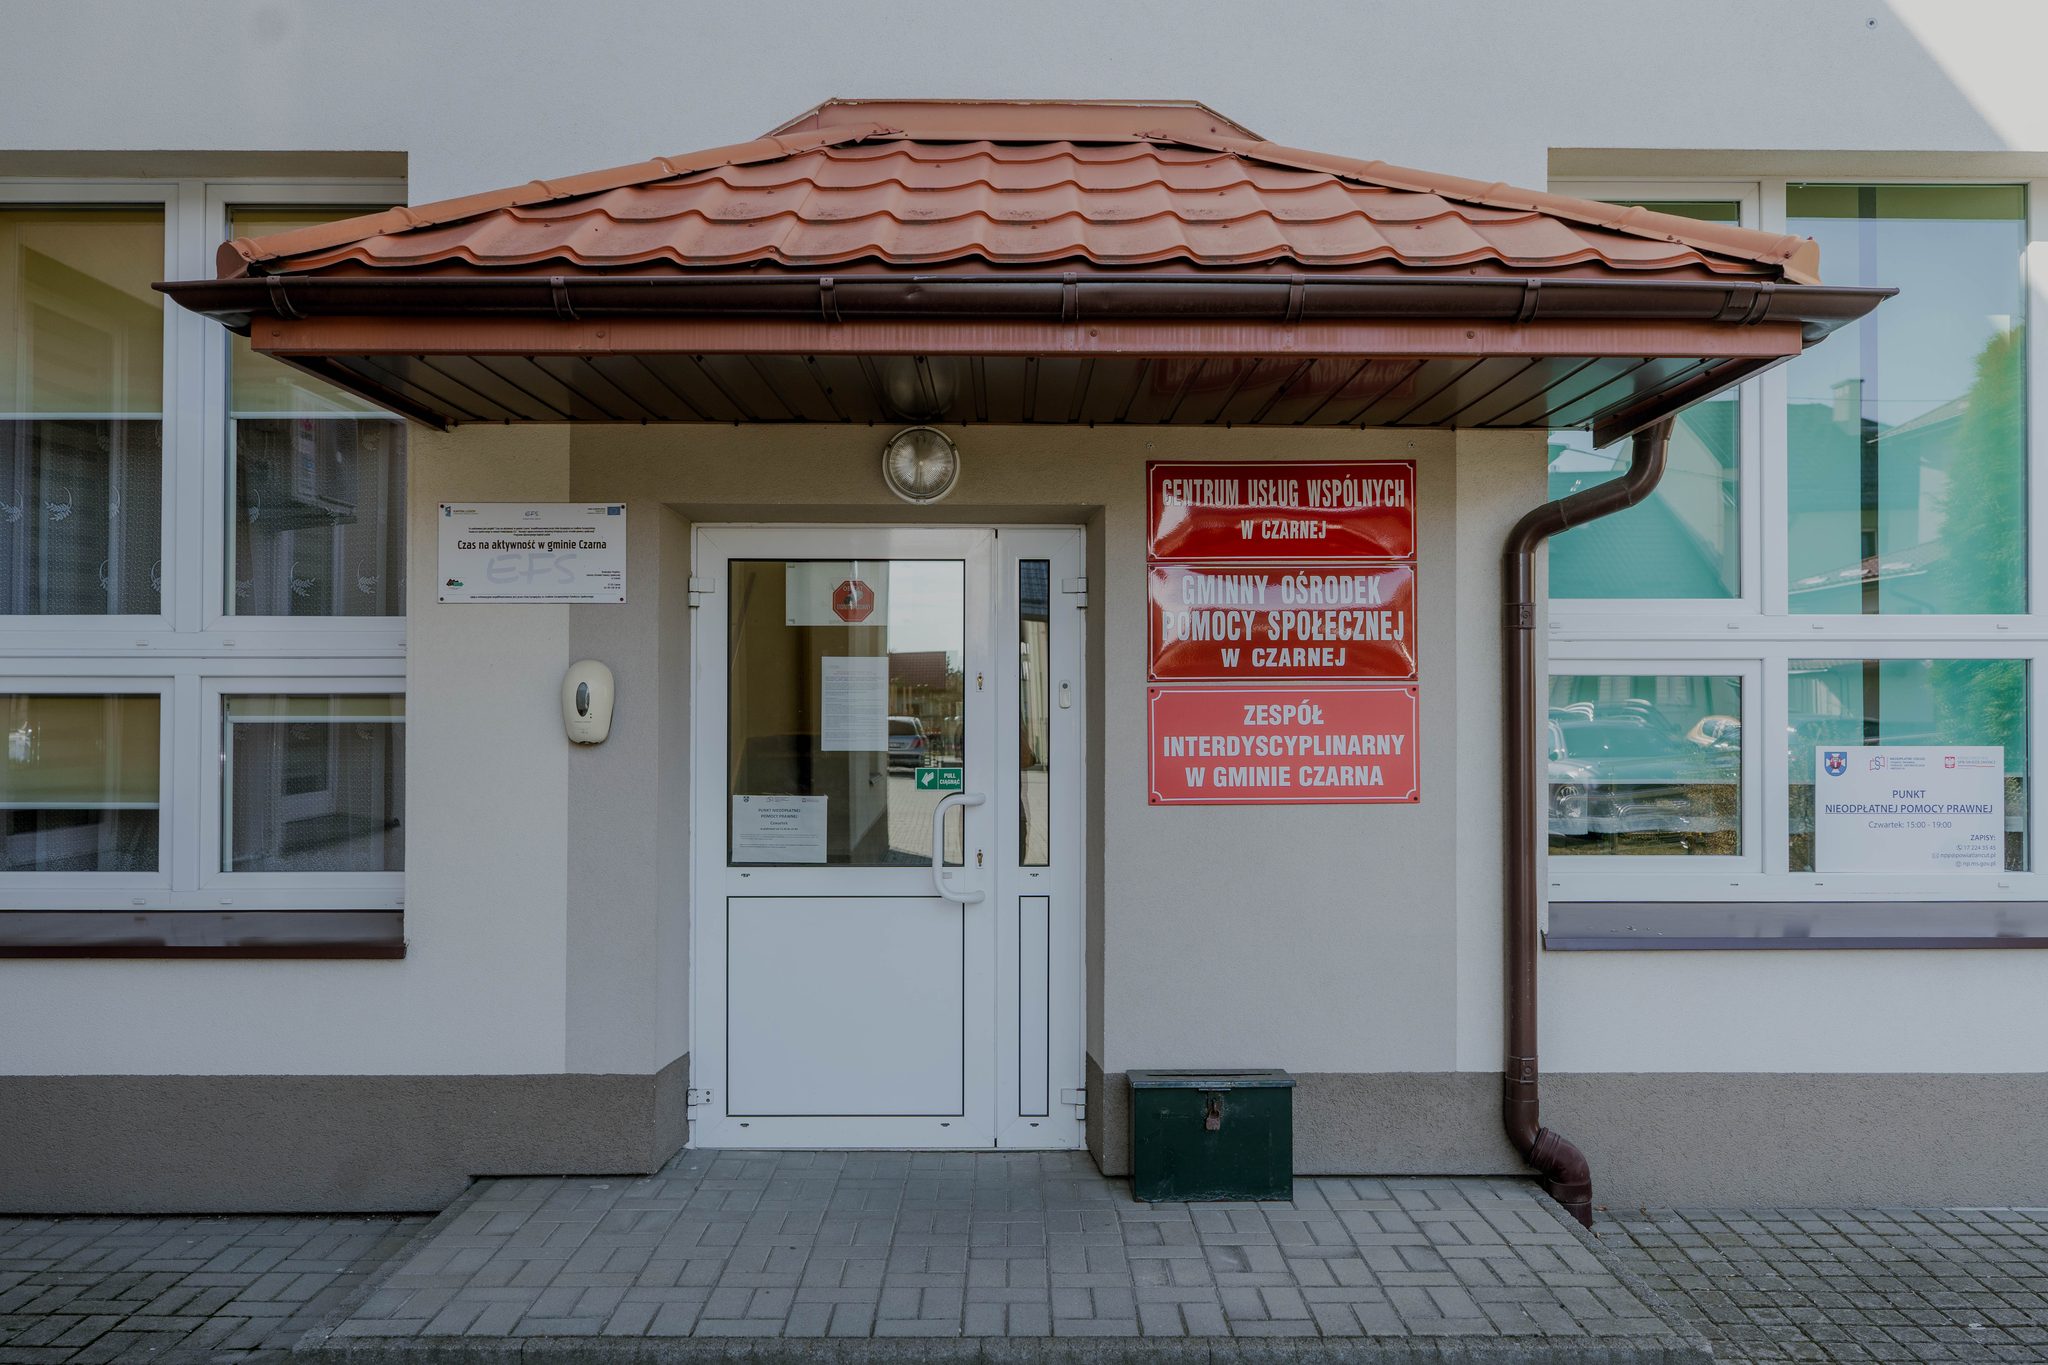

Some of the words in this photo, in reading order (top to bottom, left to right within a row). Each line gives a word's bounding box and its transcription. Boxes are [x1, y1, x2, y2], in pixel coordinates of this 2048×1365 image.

[1162, 478, 1239, 508] CENTRUM
[1248, 478, 1299, 508] USŁUG
[1307, 474, 1405, 508] WSPÓLNYCH
[1241, 519, 1254, 540] W
[1261, 519, 1327, 540] CZARNEJ
[457, 540, 476, 550] Czas
[478, 542, 489, 550] na
[491, 539, 536, 552] aktywność
[538, 542, 547, 550] w
[547, 539, 577, 552] gminie
[579, 539, 607, 550] Czarna
[1182, 574, 1269, 605] GMINNY
[1281, 570, 1382, 605] OŚRODEK
[1162, 610, 1256, 642] POMOCY
[1267, 610, 1405, 642] SPOŁECZNEJ
[1221, 647, 1240, 668] W
[1251, 647, 1346, 668] CZARNEJ
[1243, 698, 1325, 726] ZESPÓŁ
[1163, 734, 1405, 757] INTERDYSCYPLINARNY
[1185, 767, 1206, 788] W
[1213, 766, 1292, 788] GMINIE
[1298, 765, 1384, 787] CZARNA
[1892, 789, 1926, 799] PUNKT
[1825, 804, 1898, 814] NIEODPŁATNEJ
[1900, 804, 1944, 813] POMOCY
[1946, 804, 1993, 814] PRAWNEJ
[1868, 820, 1905, 829] Czwartek:
[1906, 821, 1926, 829] 15:00
[1932, 821, 1952, 829] 19:00
